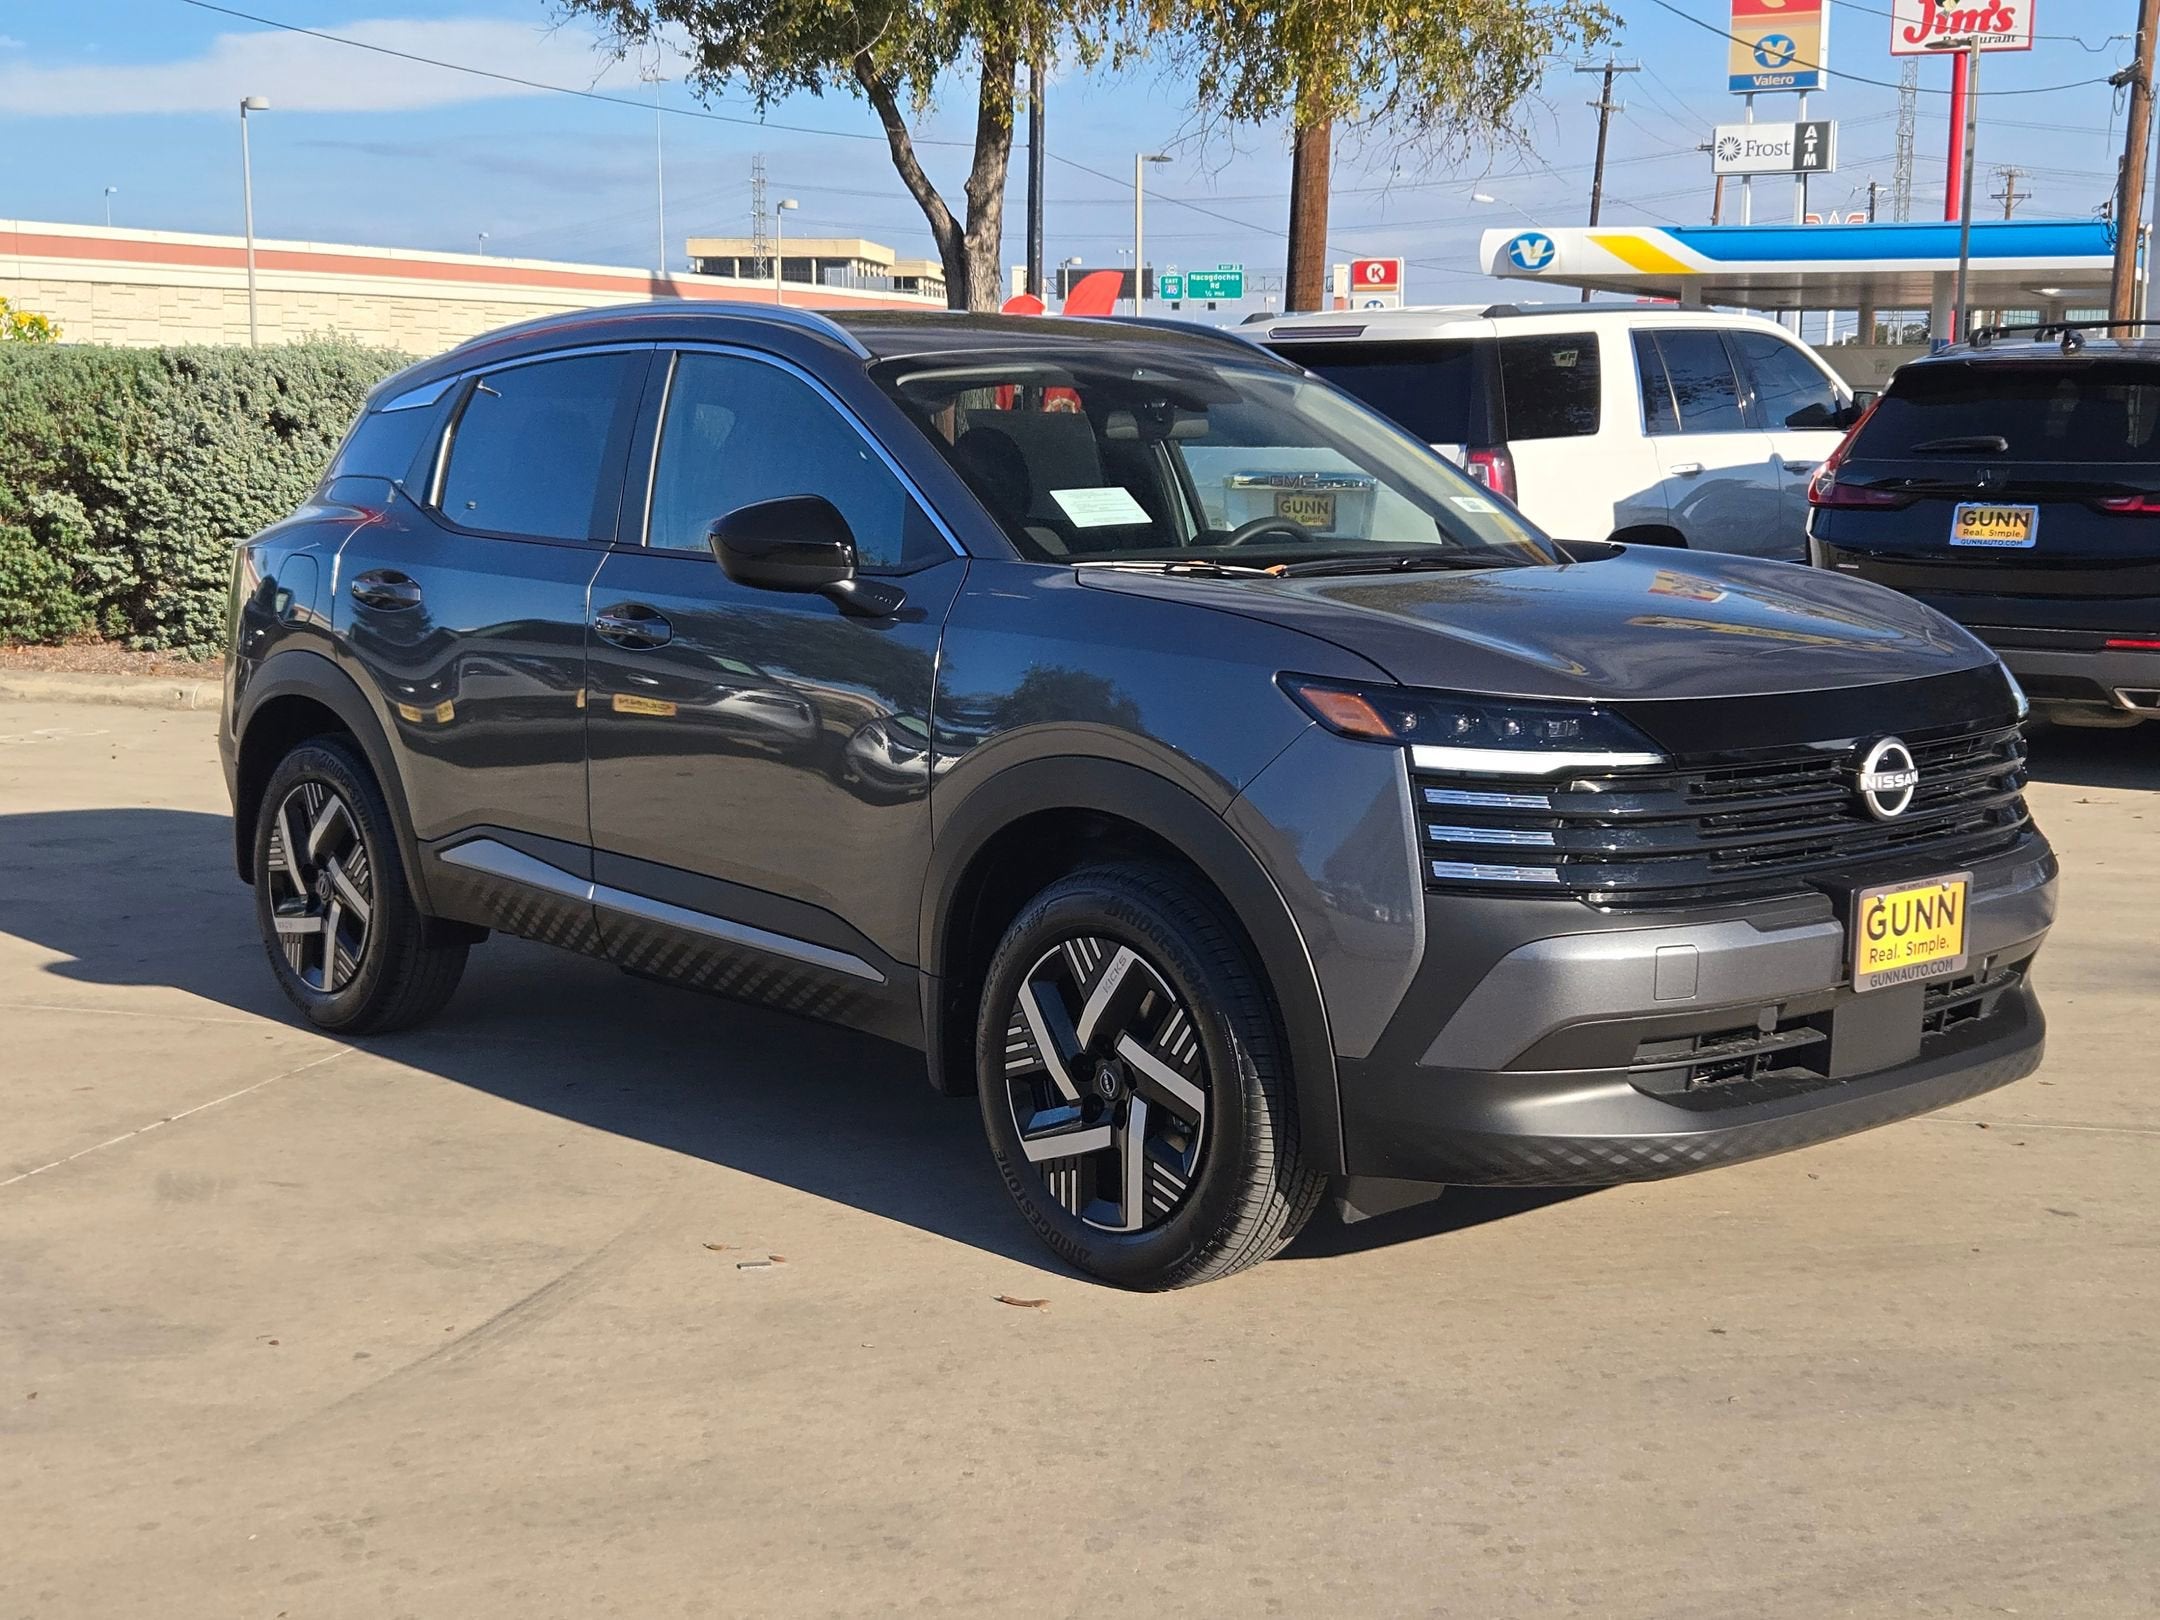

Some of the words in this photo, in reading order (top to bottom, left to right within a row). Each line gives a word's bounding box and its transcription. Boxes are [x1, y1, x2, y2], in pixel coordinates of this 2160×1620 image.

[1903, 0, 2016, 44] Jim's
[1753, 75, 1795, 87] Valero
[1744, 139, 1791, 157] Frost
[1803, 125, 1818, 167] ATM
[1190, 274, 1240, 282] Nacogdoches
[1280, 500, 1329, 514] GUNN
[1962, 510, 2030, 528] GUNN
[1963, 528, 1985, 536] Real.
[1988, 529, 2023, 538] Simple.
[1860, 770, 1918, 790] NISSAN
[1867, 891, 1957, 941] GUNN
[1869, 944, 1901, 964] Real.
[1906, 934, 1950, 956] Simple.
[1103, 955, 1126, 993] KICKS
[1870, 958, 1954, 987] GUNNAUTO.COM
